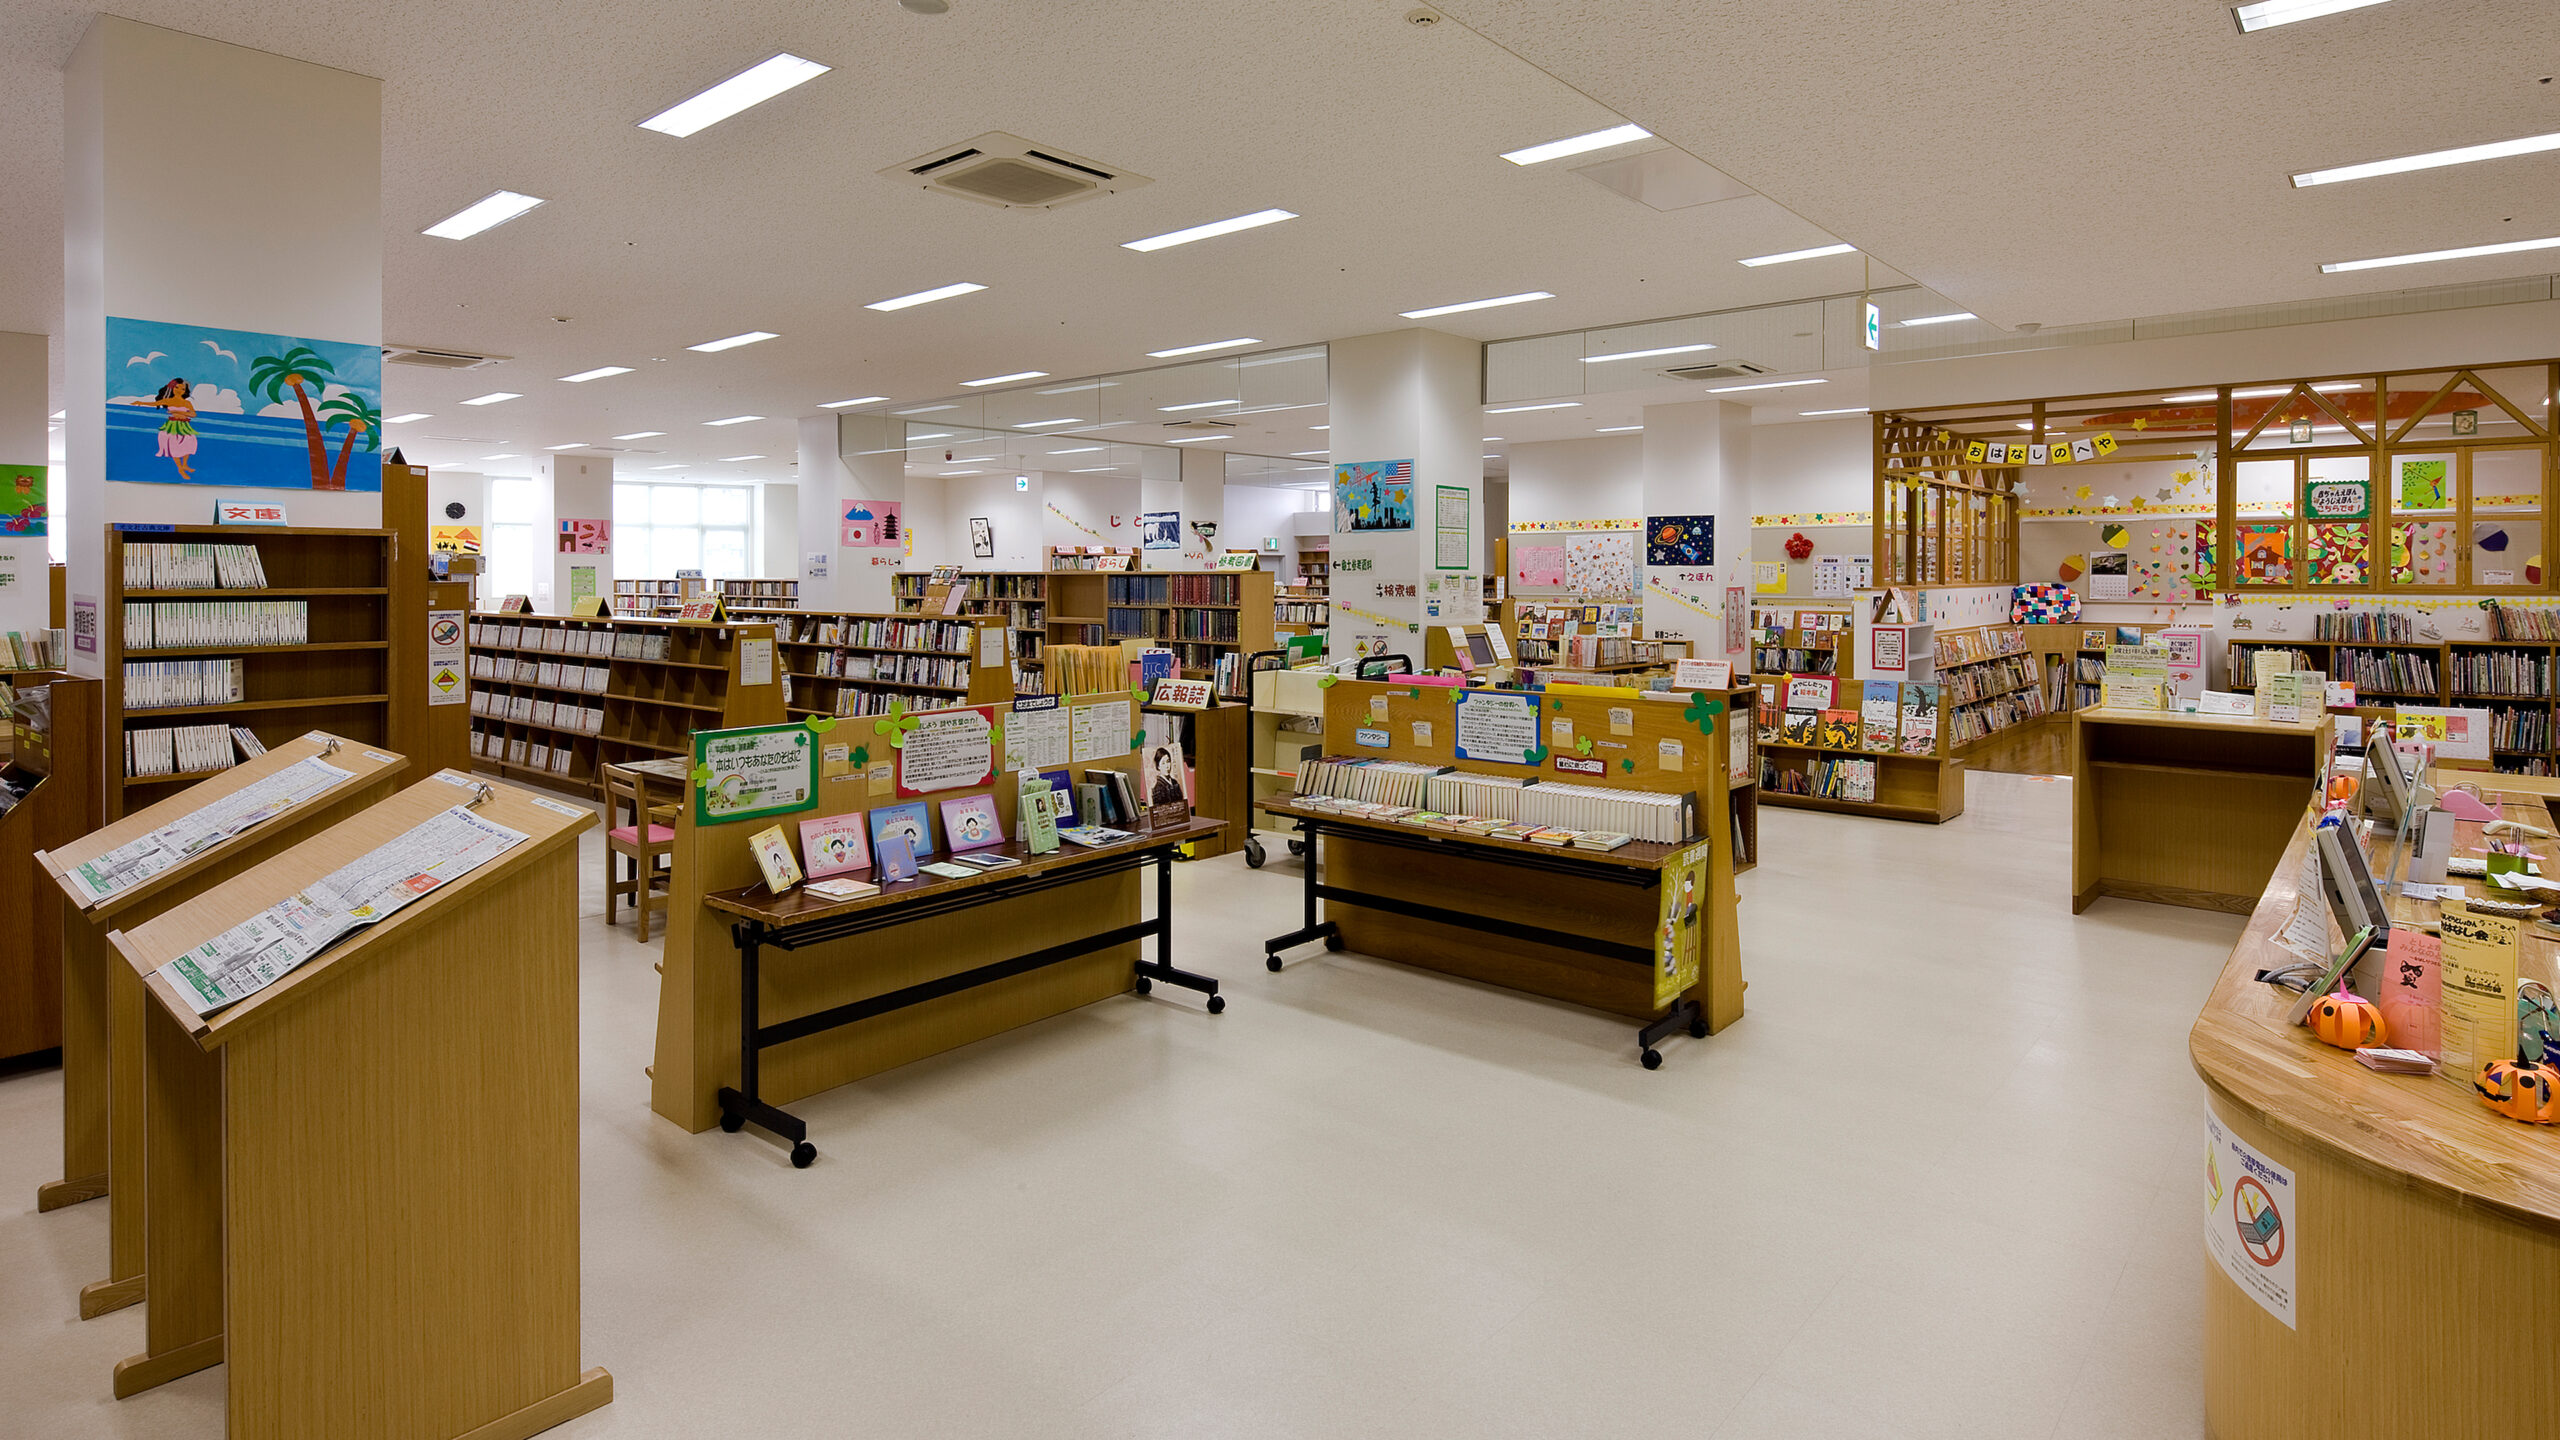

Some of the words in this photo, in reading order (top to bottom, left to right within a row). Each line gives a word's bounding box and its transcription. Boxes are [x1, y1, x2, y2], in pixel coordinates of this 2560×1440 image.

[1969, 437, 2111, 460] おはなしのへや
[224, 507, 281, 520] 文庫
[1098, 558, 1126, 569] 暮らし
[1218, 556, 1254, 567] 参考図書
[1687, 572, 1714, 582] えほん
[1384, 584, 1417, 597] 検索機
[680, 602, 714, 618] 新書
[1155, 683, 1206, 704] 広報誌
[715, 750, 801, 772] 本はいつもあなたのそばに
